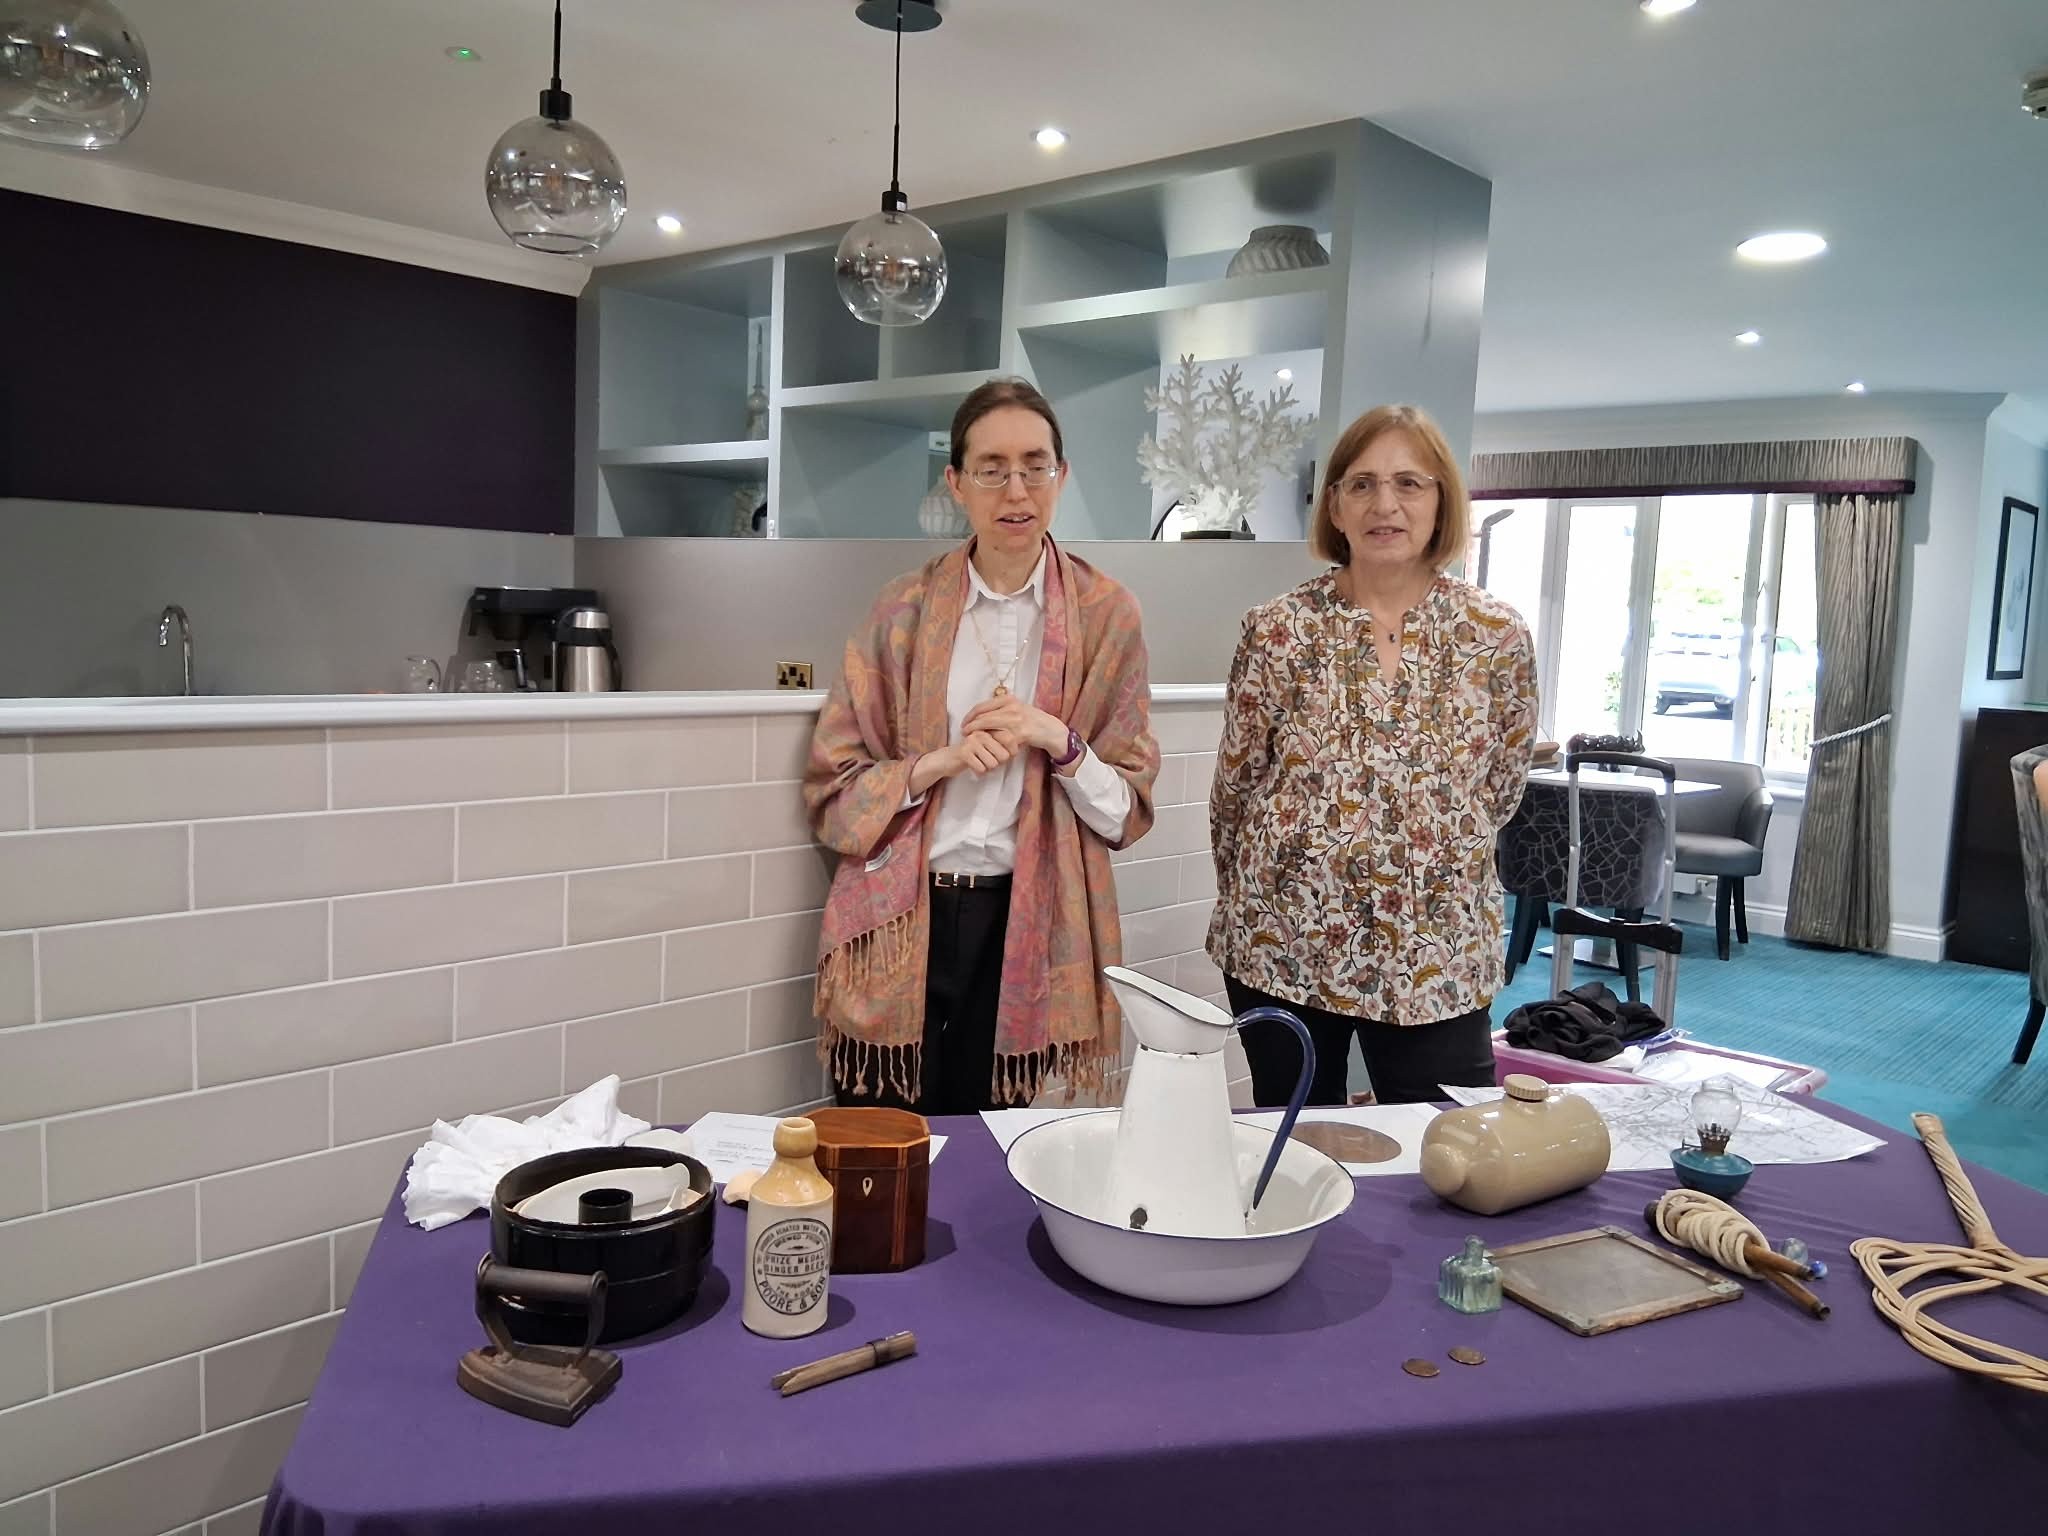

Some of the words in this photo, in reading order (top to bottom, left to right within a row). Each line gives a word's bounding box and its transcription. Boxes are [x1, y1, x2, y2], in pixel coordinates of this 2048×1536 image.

[765, 1254, 790, 1265] PRIZE
[797, 1251, 824, 1264] MEDAL
[764, 1264, 799, 1275] GINGER
[804, 1259, 825, 1272] BEER
[759, 1280, 793, 1313] POORE
[810, 1275, 826, 1302] SON
